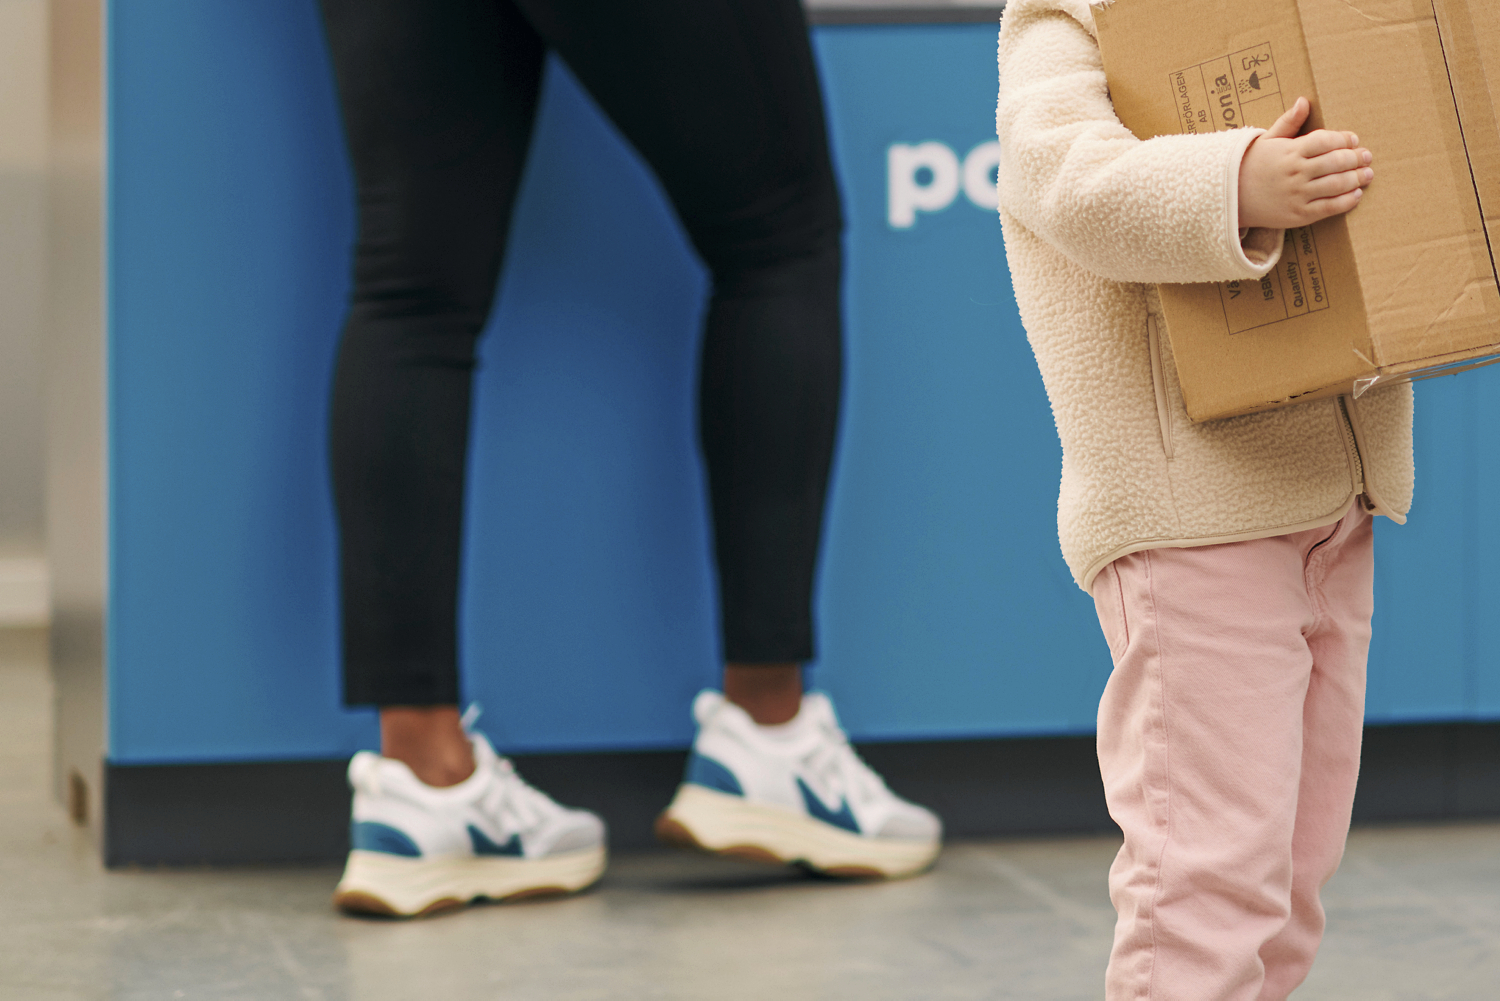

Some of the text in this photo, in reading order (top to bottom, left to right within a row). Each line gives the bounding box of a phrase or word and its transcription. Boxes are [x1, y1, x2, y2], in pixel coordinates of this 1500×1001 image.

[1198, 110, 1207, 123] AB
[1287, 262, 1303, 307] Quantity
[1312, 276, 1323, 302] Order
